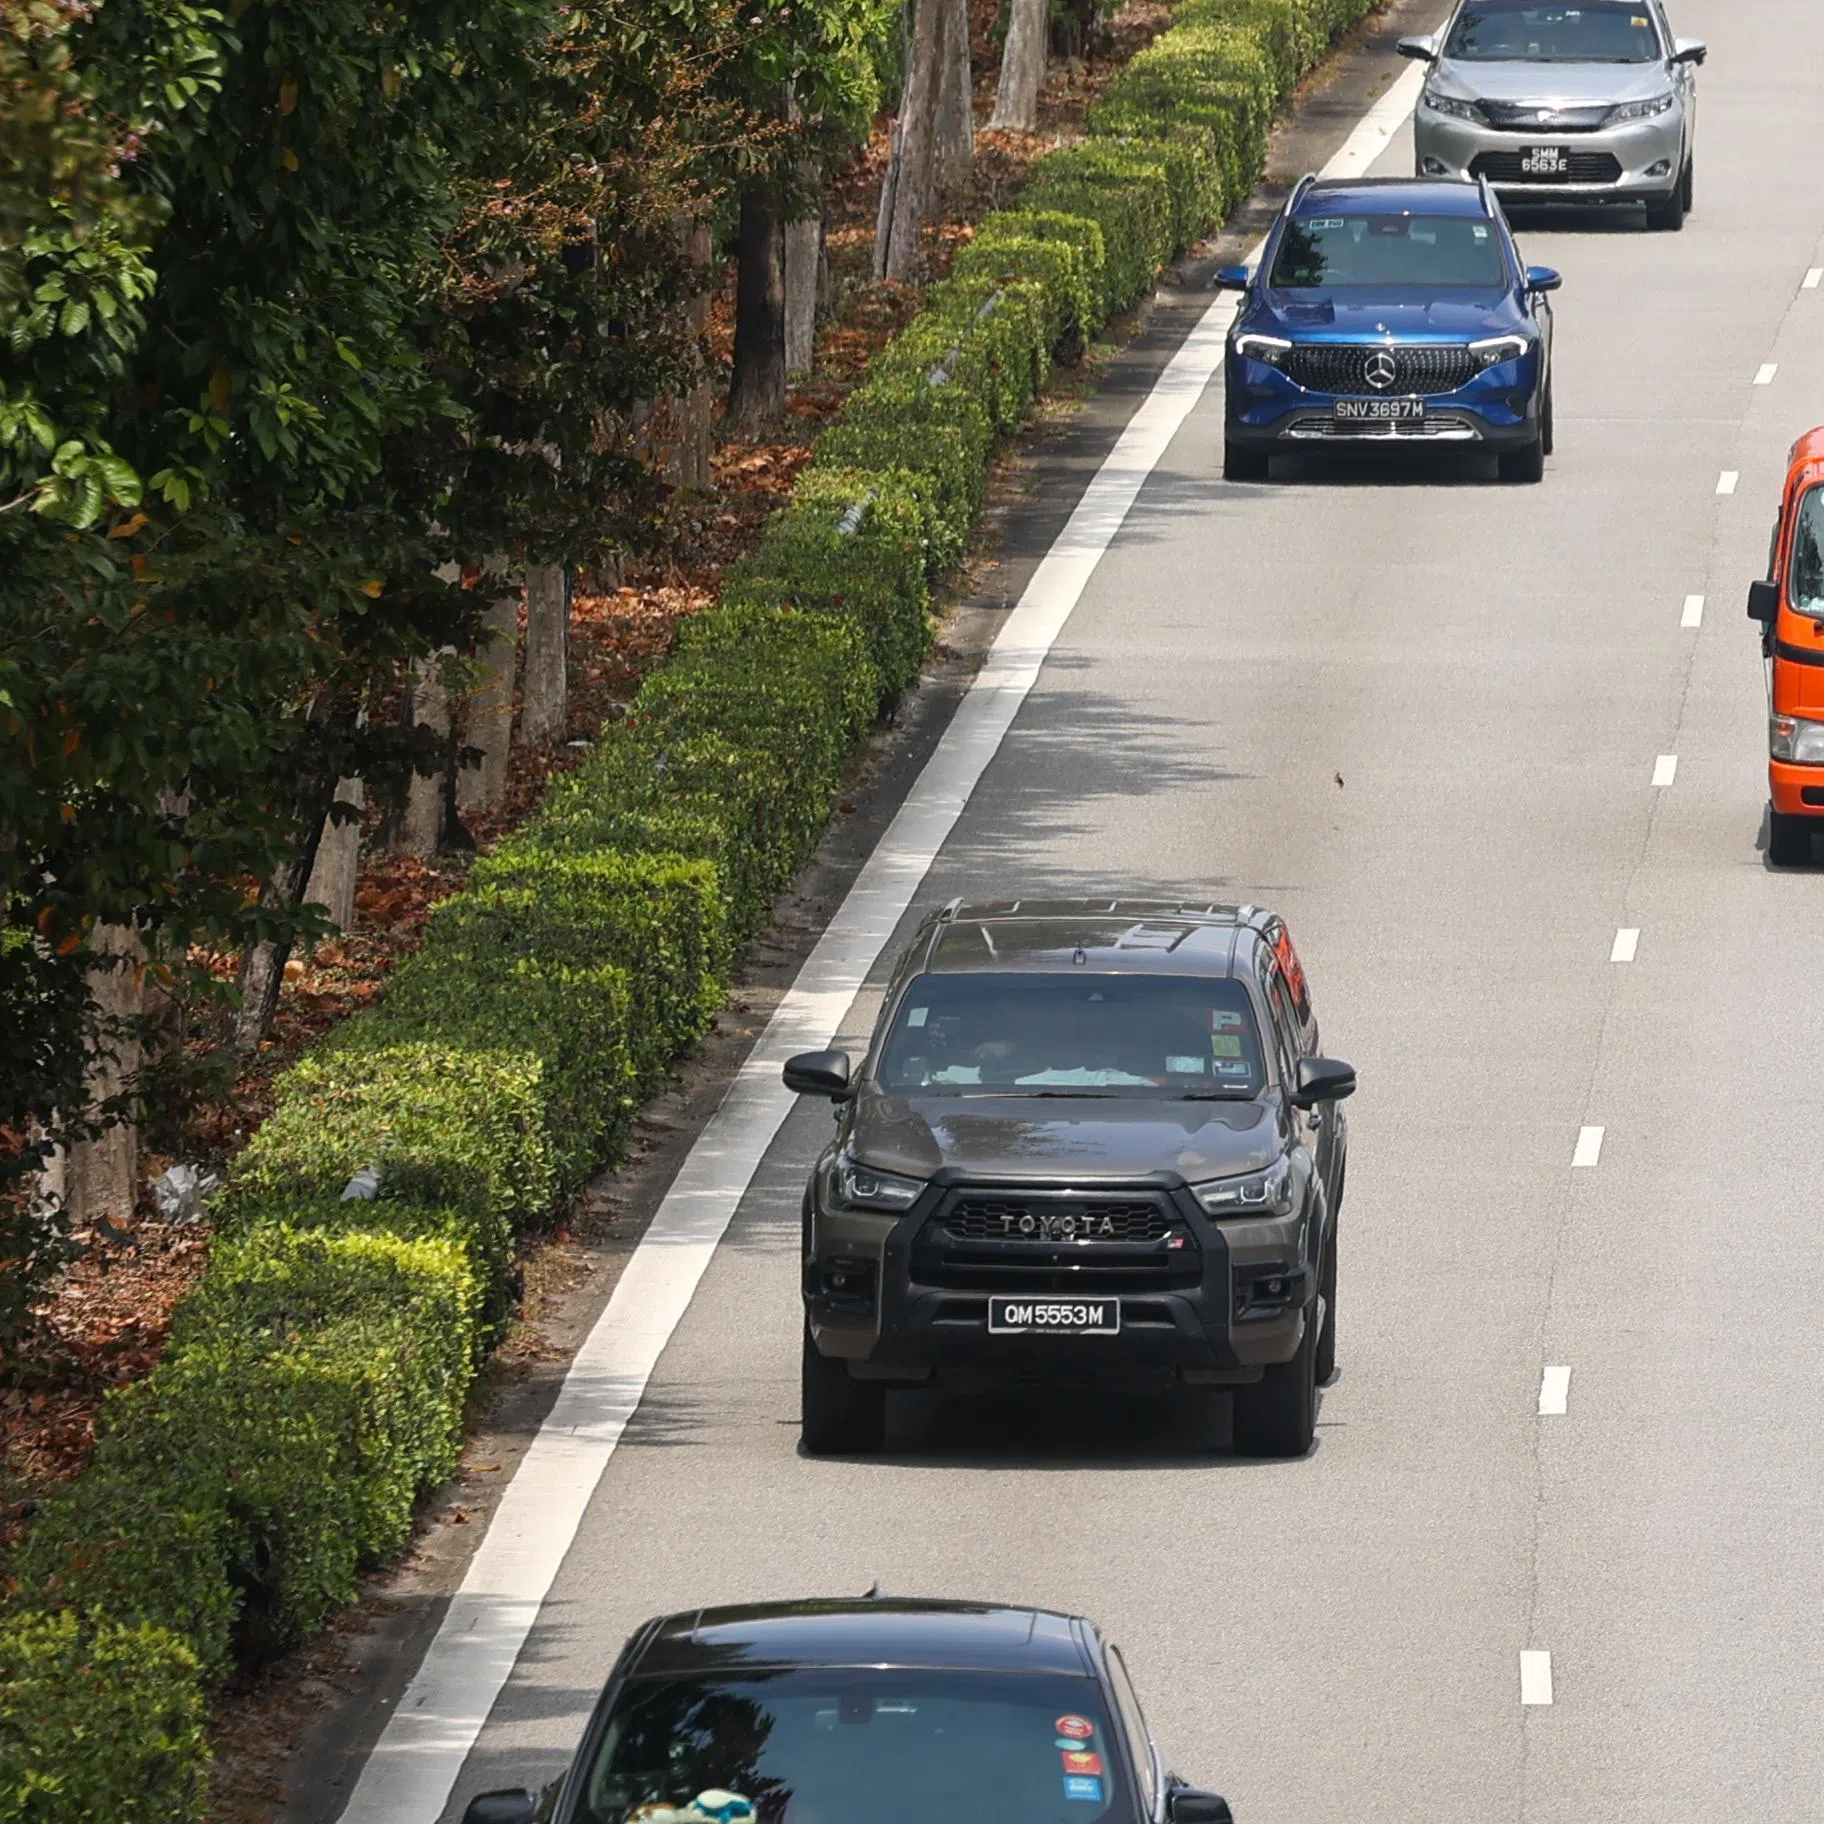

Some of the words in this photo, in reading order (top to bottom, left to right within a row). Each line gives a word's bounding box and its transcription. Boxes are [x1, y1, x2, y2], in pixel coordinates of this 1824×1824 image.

[1532, 148, 1559, 160] SMM
[1522, 159, 1568, 172] 6563E
[1000, 1215, 1115, 1234] TOYOTA
